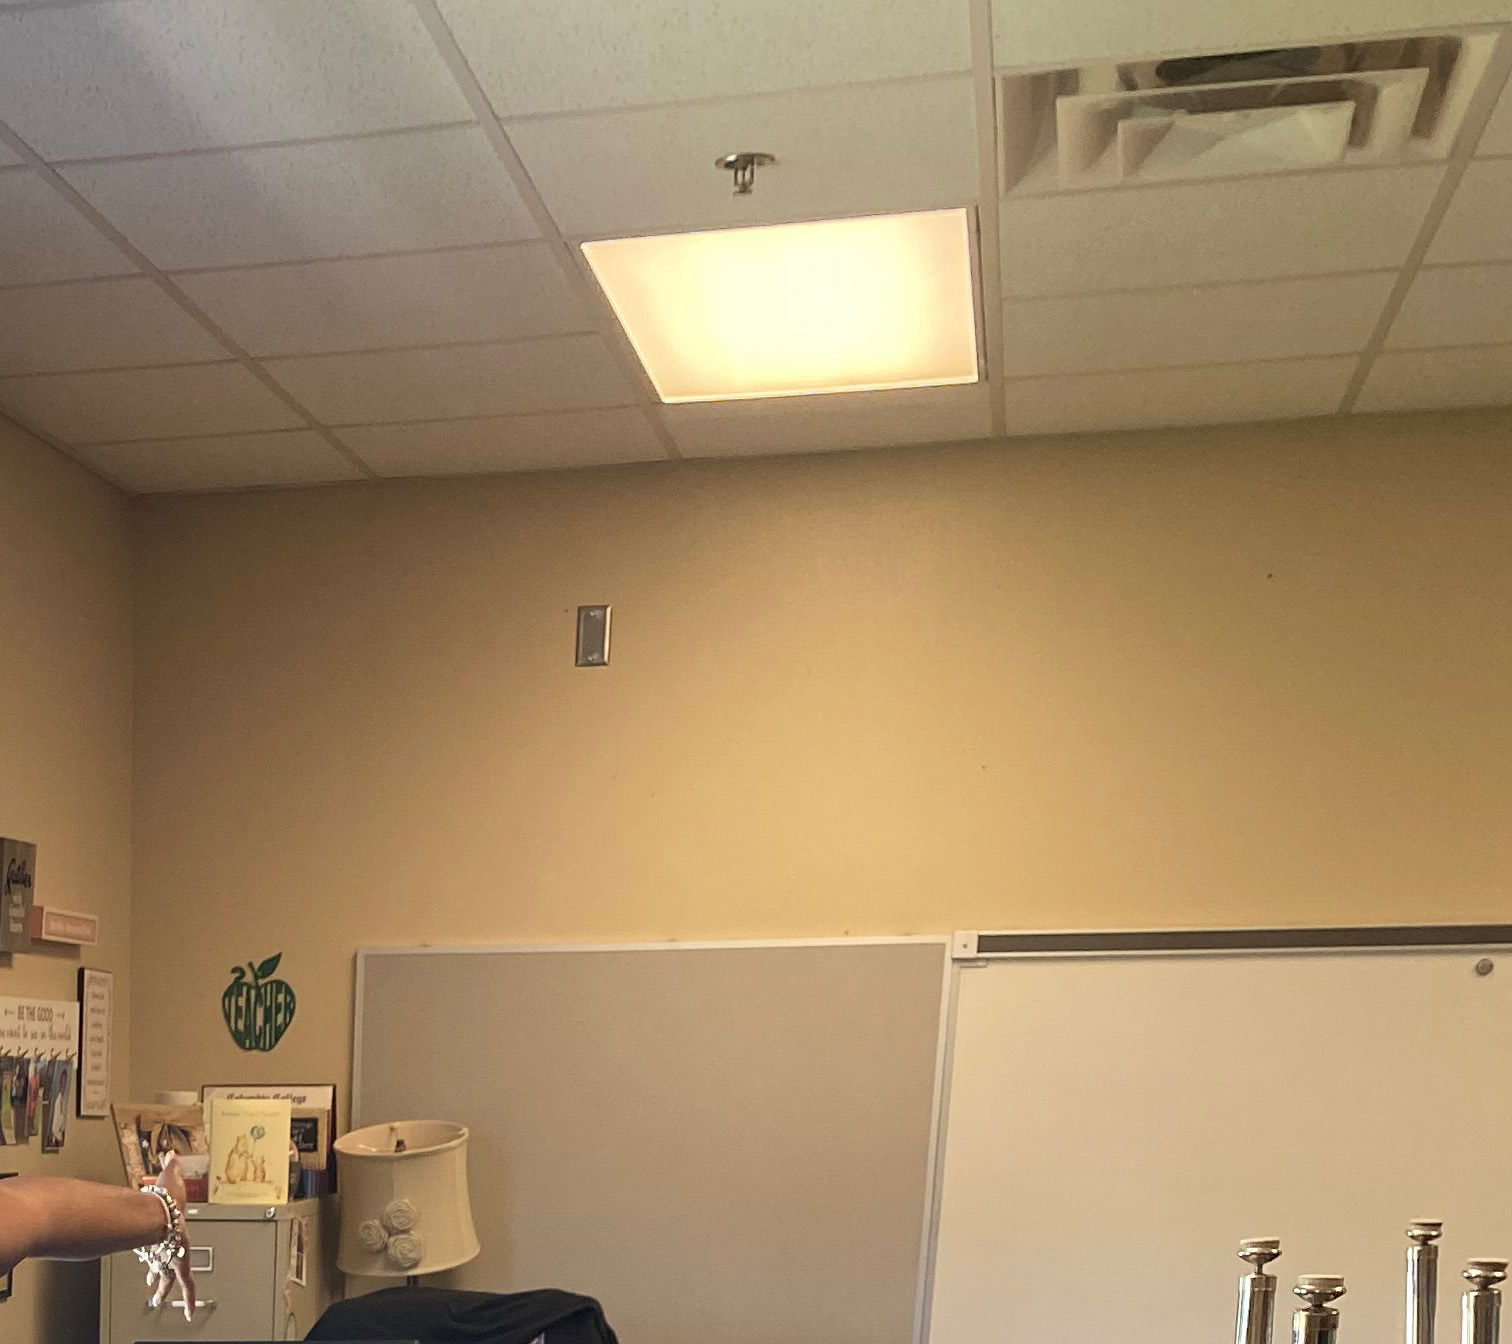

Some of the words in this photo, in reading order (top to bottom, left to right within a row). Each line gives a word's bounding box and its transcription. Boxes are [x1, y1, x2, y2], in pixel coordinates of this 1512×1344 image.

[17, 1005, 25, 1020] BE
[26, 1006, 36, 1021] THE
[37, 1007, 54, 1022] GOOD
[224, 981, 292, 1052] TEACHER
